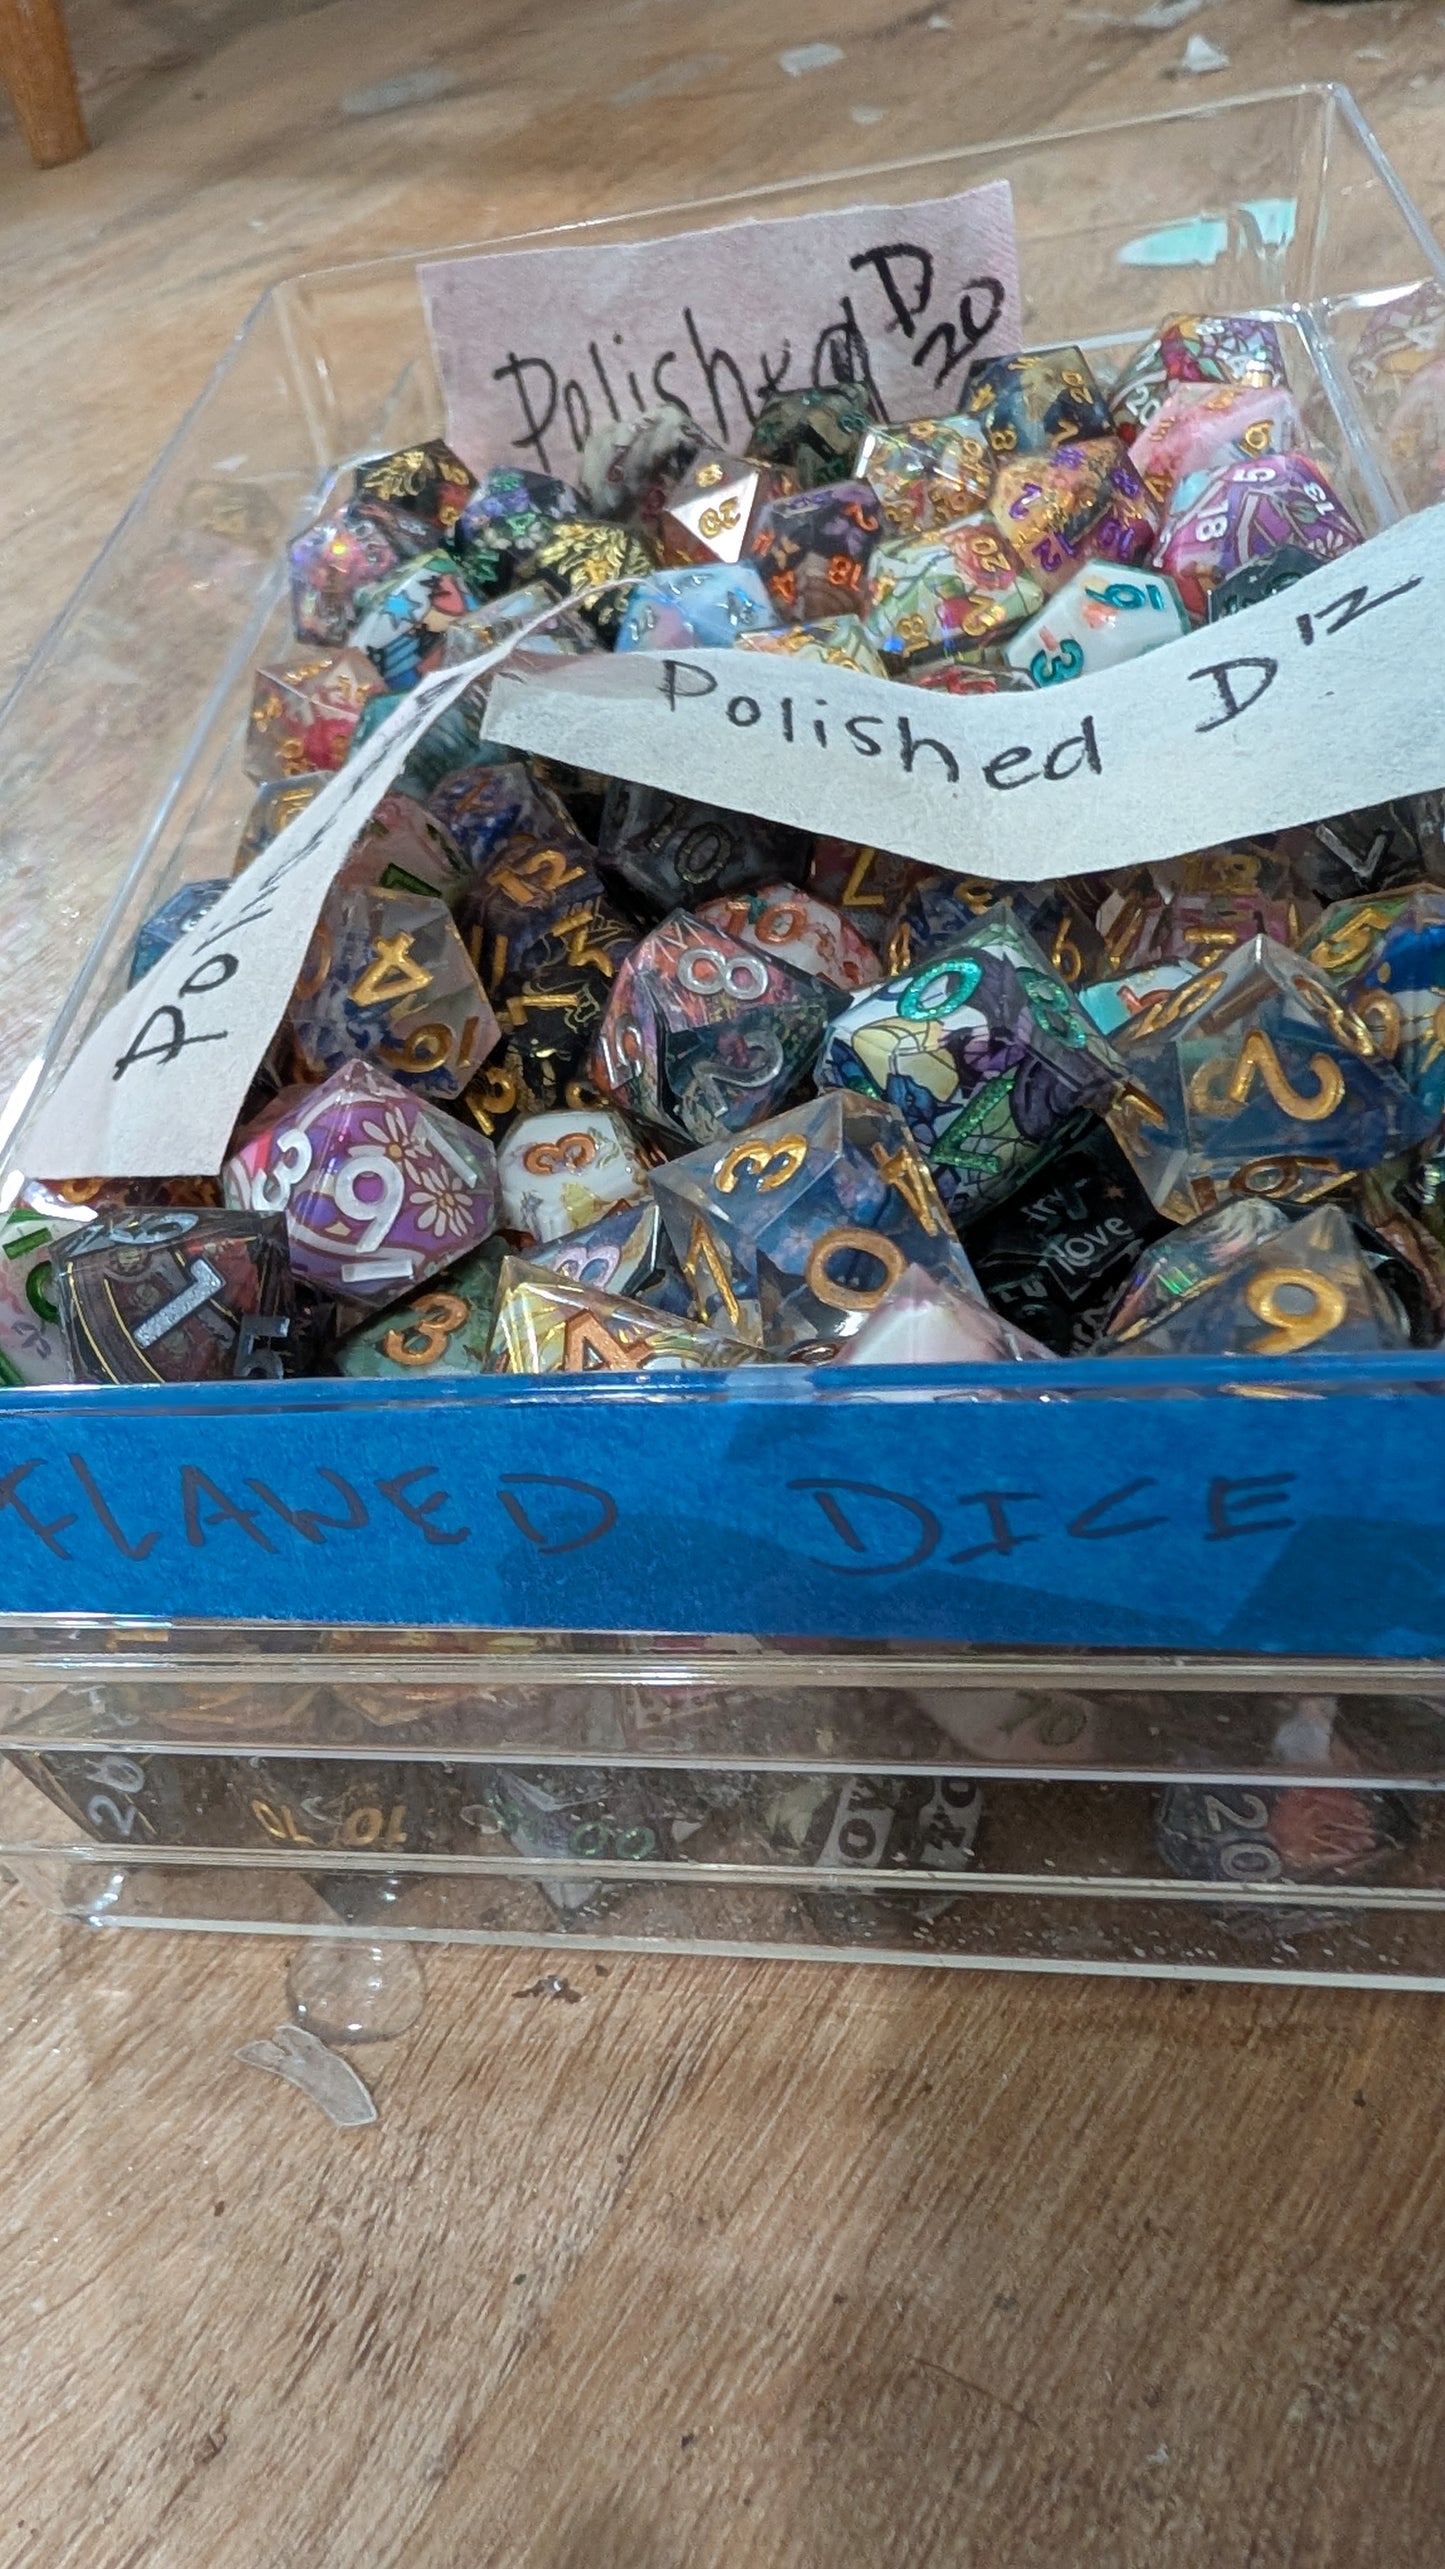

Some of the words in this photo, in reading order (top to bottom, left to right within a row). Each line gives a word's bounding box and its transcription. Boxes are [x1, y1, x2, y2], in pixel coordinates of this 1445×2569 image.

[1195, 500, 1229, 543] 18
[1029, 638, 1084, 687] 3
[659, 658, 1102, 792] Polished
[488, 849, 587, 906] 12
[349, 930, 434, 1007] 4
[252, 1128, 313, 1212] 3
[714, 1133, 808, 1194] 3
[334, 1156, 405, 1254] 9
[385, 1293, 471, 1366] 3
[0, 1452, 618, 1562] FLAWED
[786, 1472, 1297, 1576] DICE
